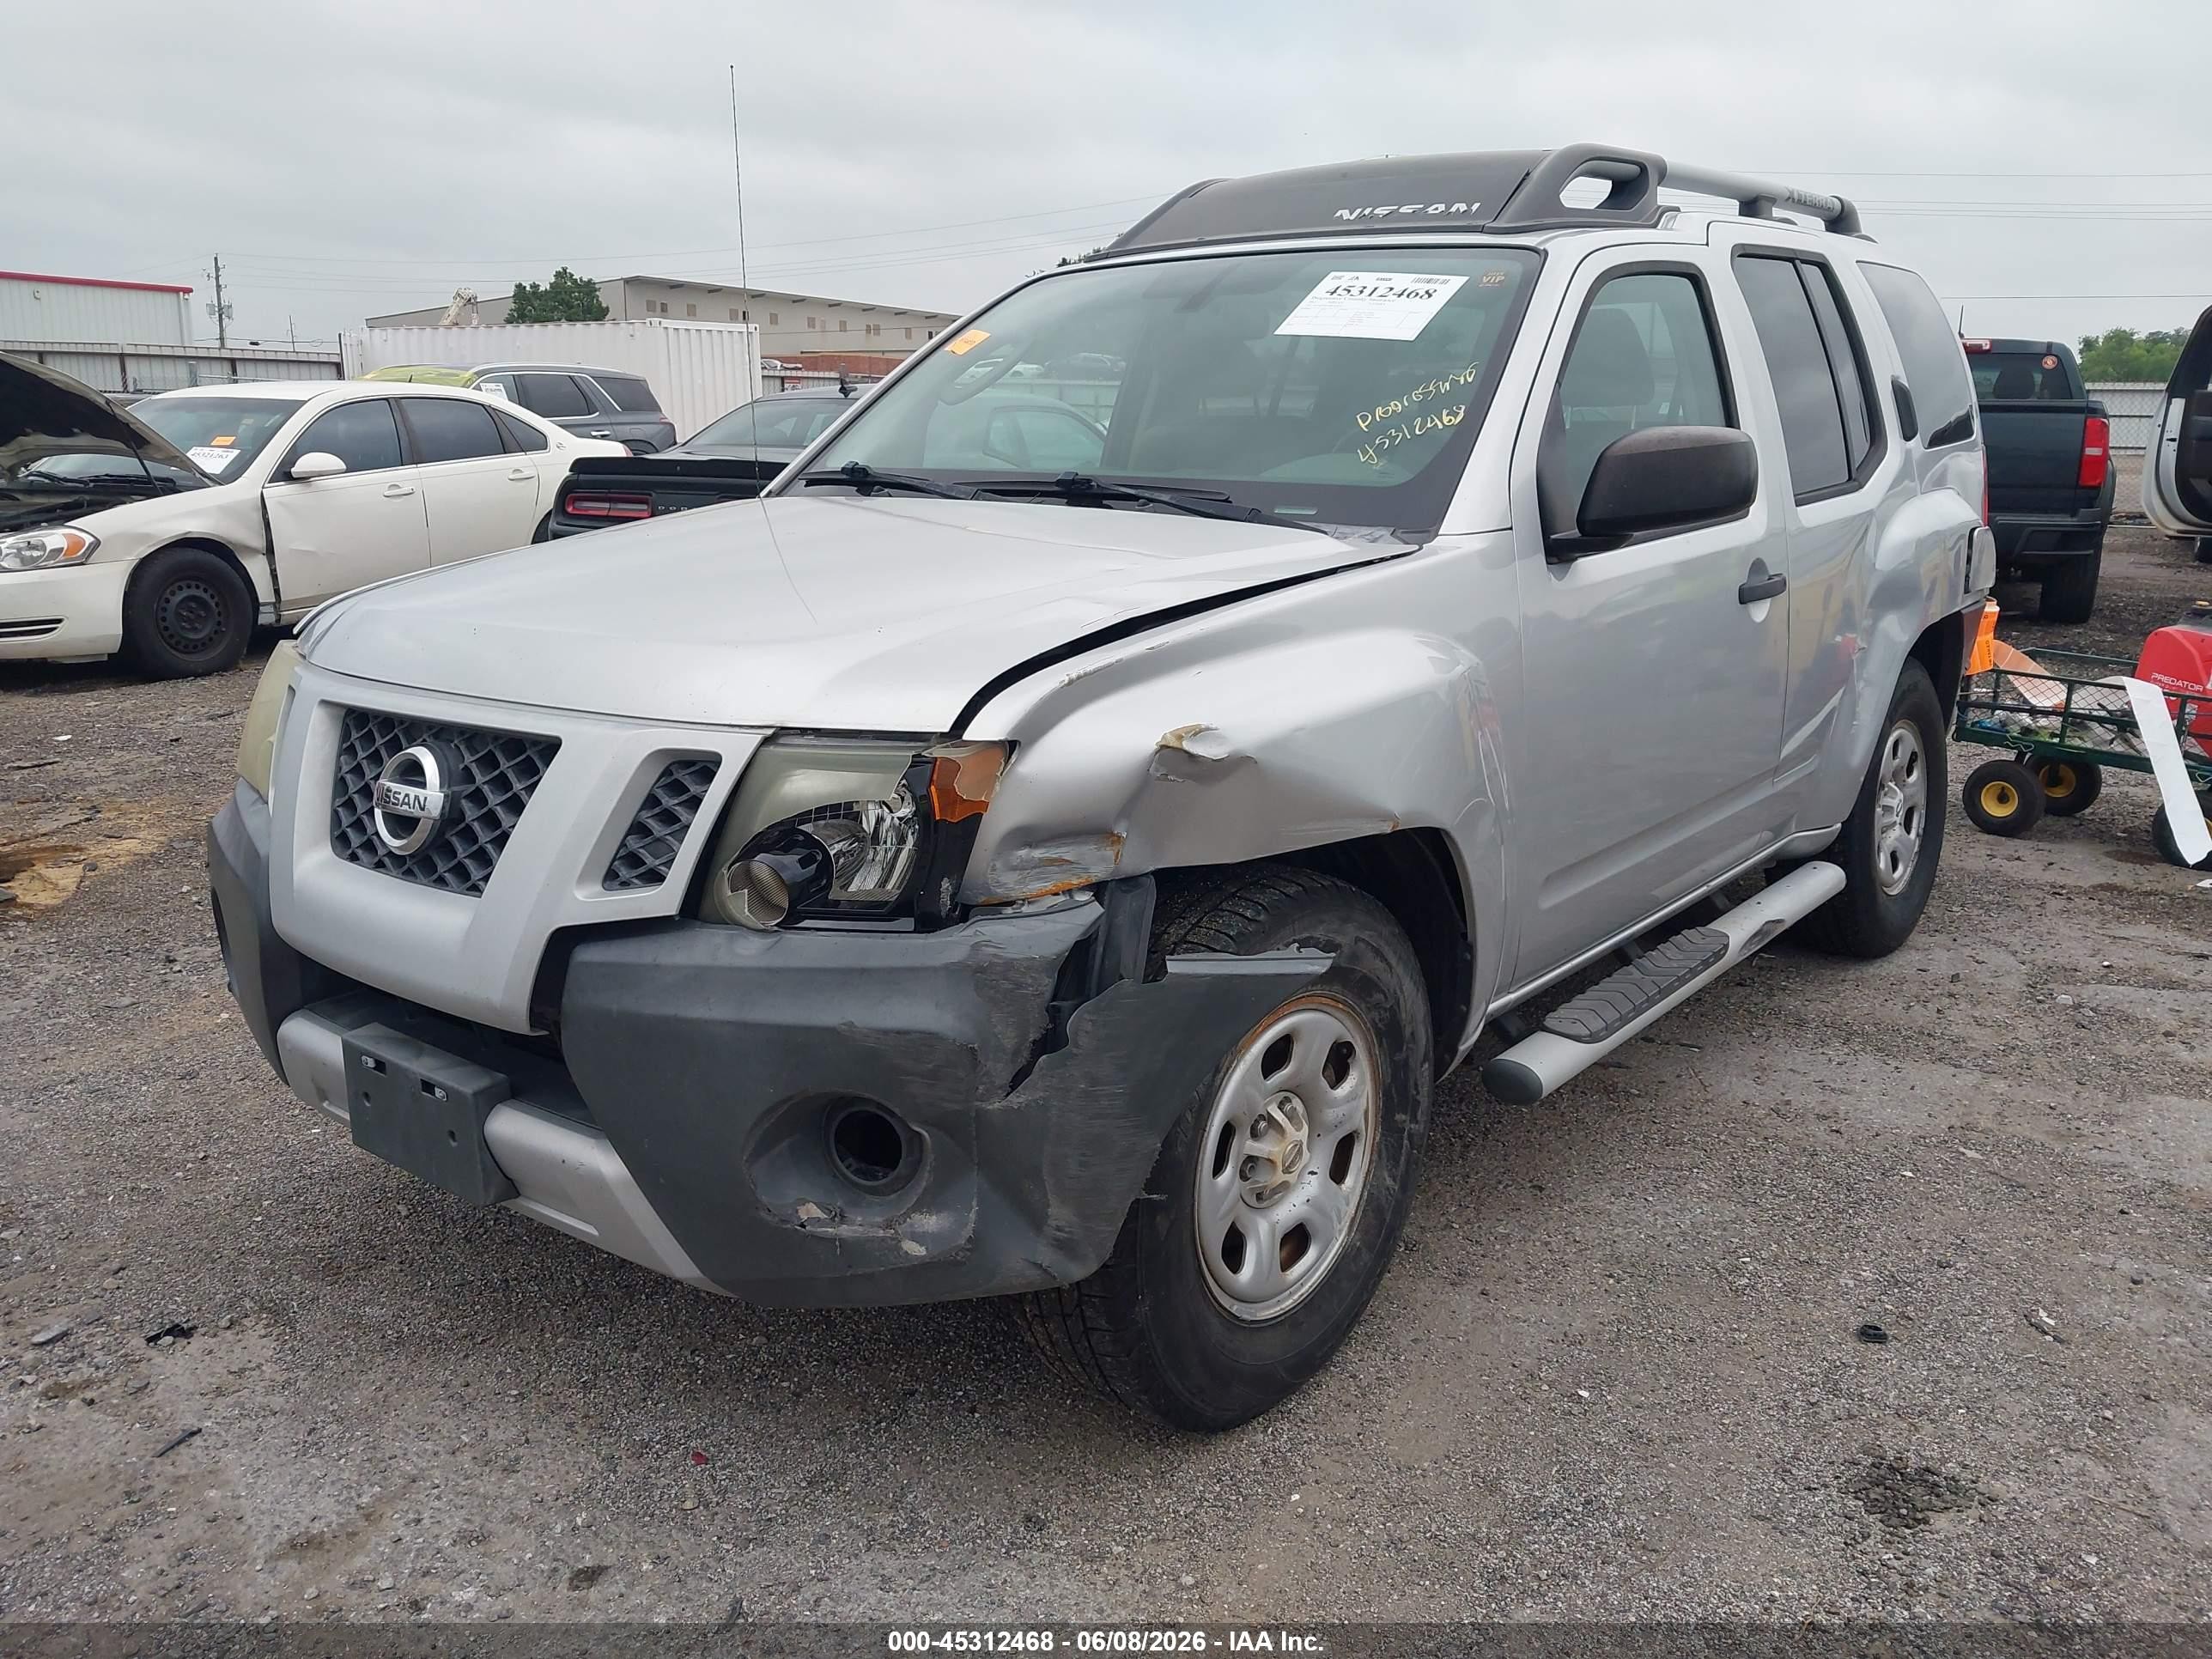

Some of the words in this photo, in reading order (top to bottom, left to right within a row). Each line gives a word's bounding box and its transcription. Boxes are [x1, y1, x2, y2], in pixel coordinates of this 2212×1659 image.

[1334, 203, 1481, 221] NISSAN
[1325, 284, 1437, 300] 45312468
[1357, 404, 1465, 464] 45312468
[2151, 672, 2203, 692] PREDATOR
[375, 785, 428, 811] NISSAN
